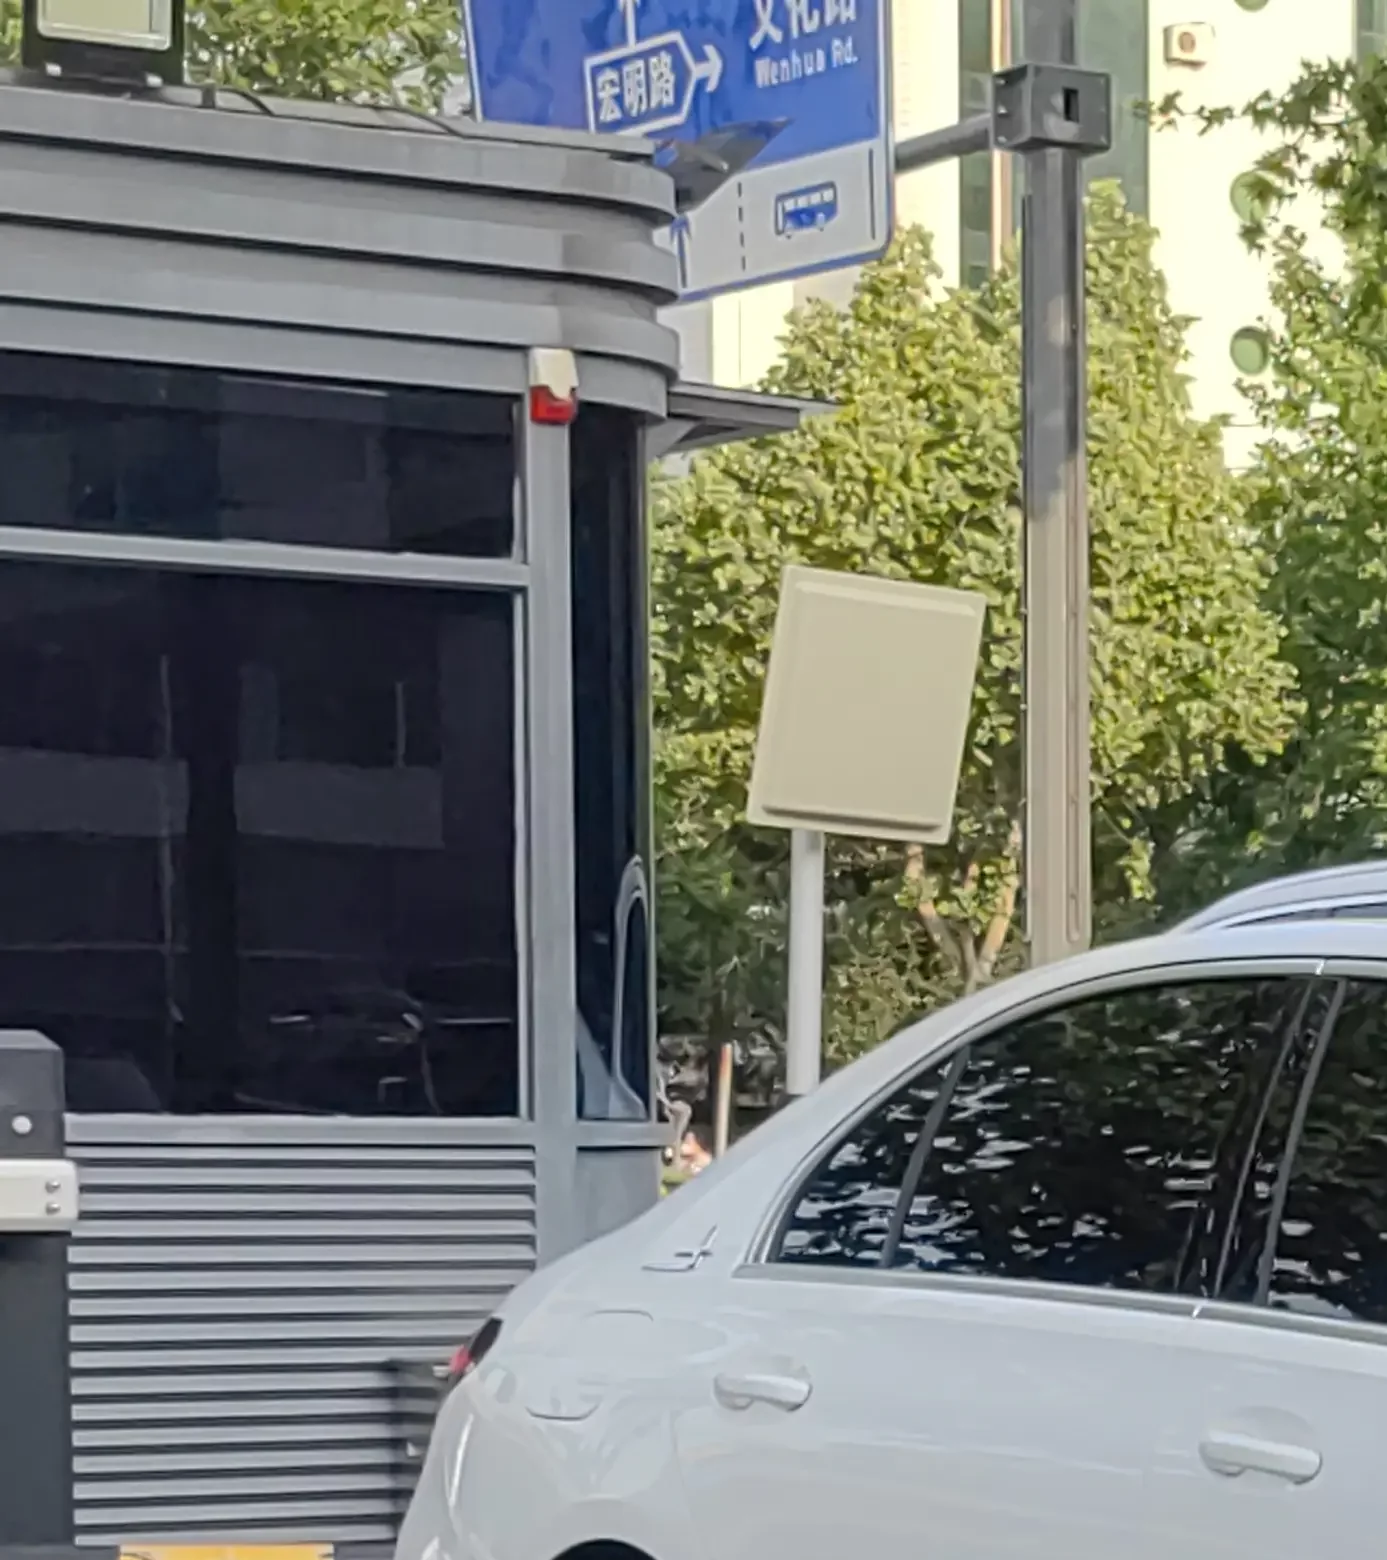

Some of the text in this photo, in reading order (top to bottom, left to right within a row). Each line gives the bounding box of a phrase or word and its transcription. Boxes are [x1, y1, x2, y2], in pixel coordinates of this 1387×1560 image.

[596, 50, 674, 121] 宏明路
[755, 36, 859, 88] Wenhua Rd.
